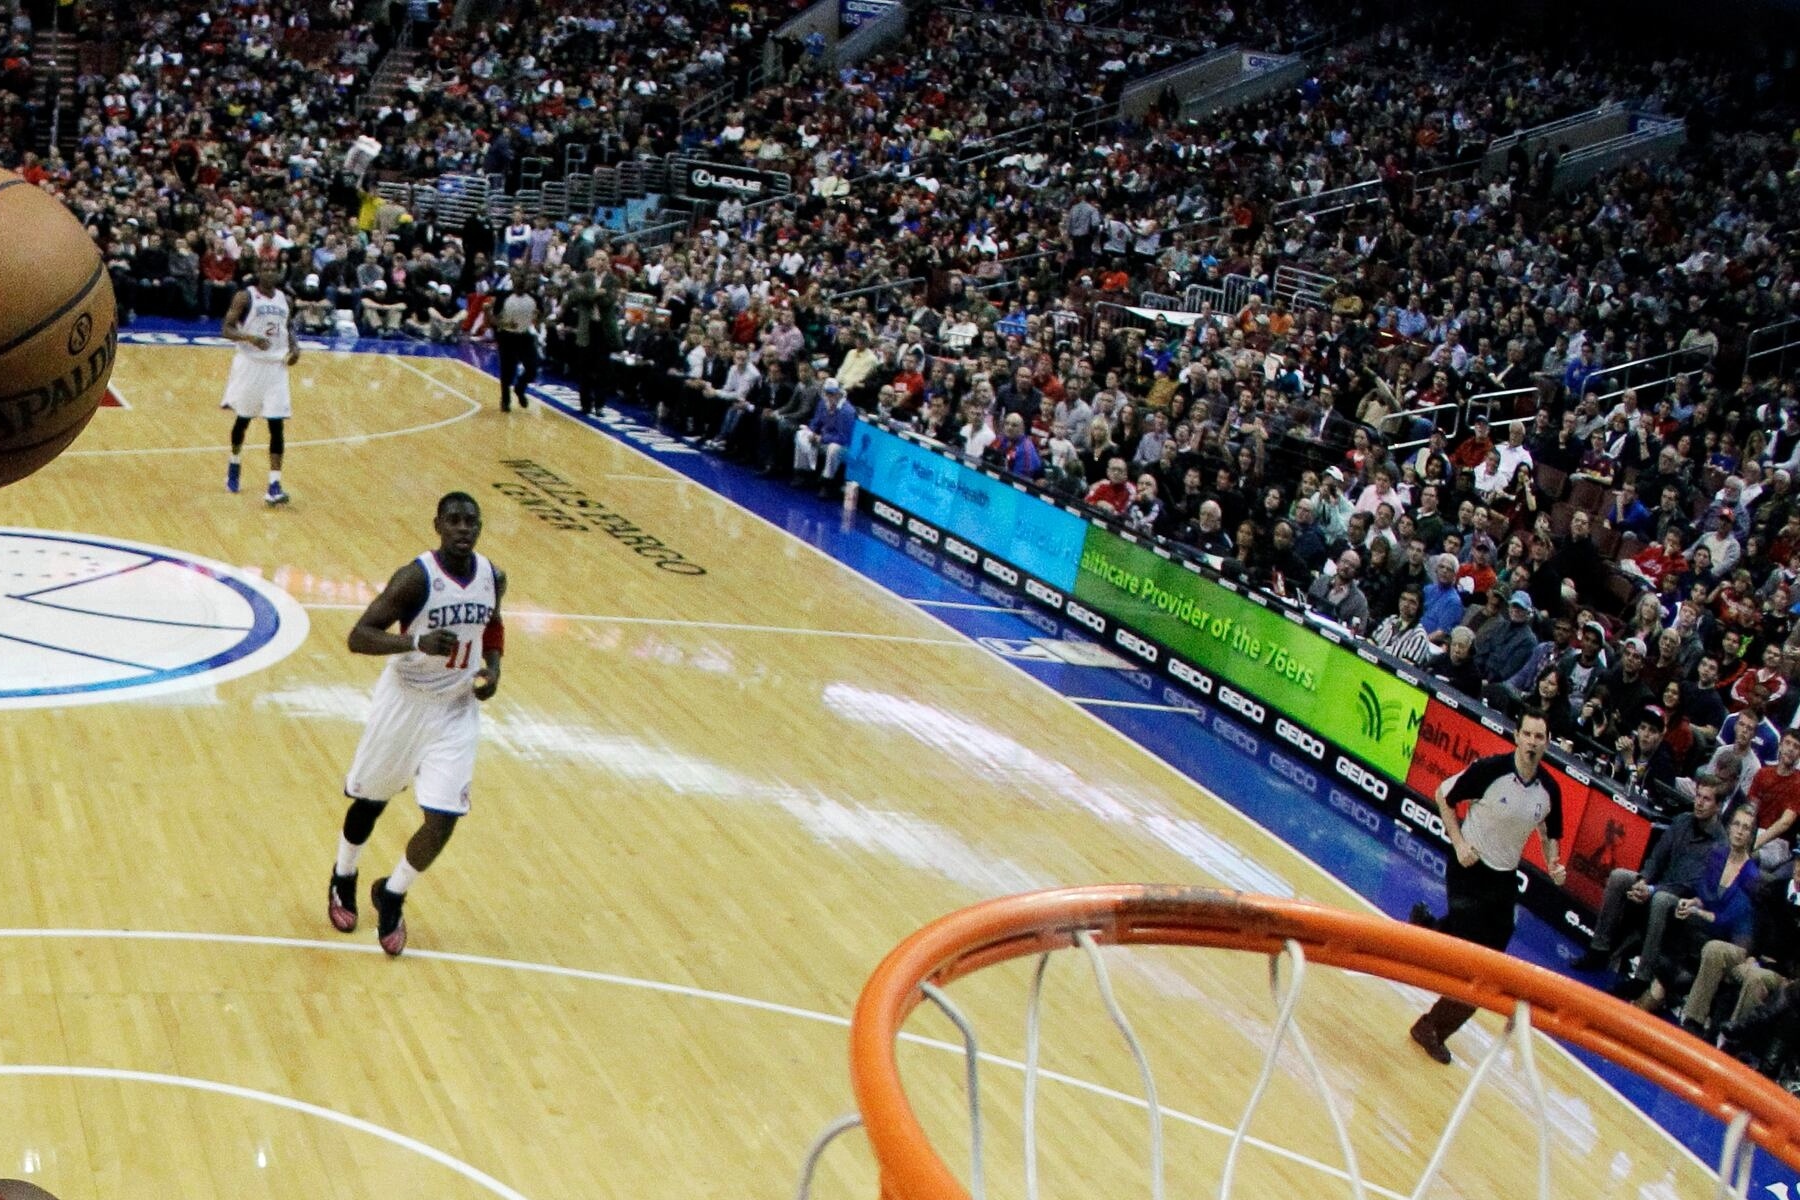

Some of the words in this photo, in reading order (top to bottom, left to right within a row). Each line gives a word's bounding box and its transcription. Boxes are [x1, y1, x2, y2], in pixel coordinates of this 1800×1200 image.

[711, 173, 762, 192] LEXUS
[491, 482, 590, 533] CENTER
[578, 512, 707, 576] FARGO
[944, 537, 978, 564] GEICO
[982, 557, 1018, 586] GEICO
[1025, 578, 1063, 609] GEICO
[1066, 600, 1106, 633] GEICO
[1116, 628, 1158, 663] GEICO
[1142, 578, 1209, 631] Provider
[1210, 616, 1232, 643] of
[1233, 625, 1261, 660] the
[1264, 642, 1316, 692] 76ers.
[445, 639, 472, 669] 11
[1168, 658, 1213, 695] GEICO
[1218, 685, 1266, 724] GEICO
[1275, 718, 1326, 760] GEICO
[1335, 755, 1389, 801] GEICO
